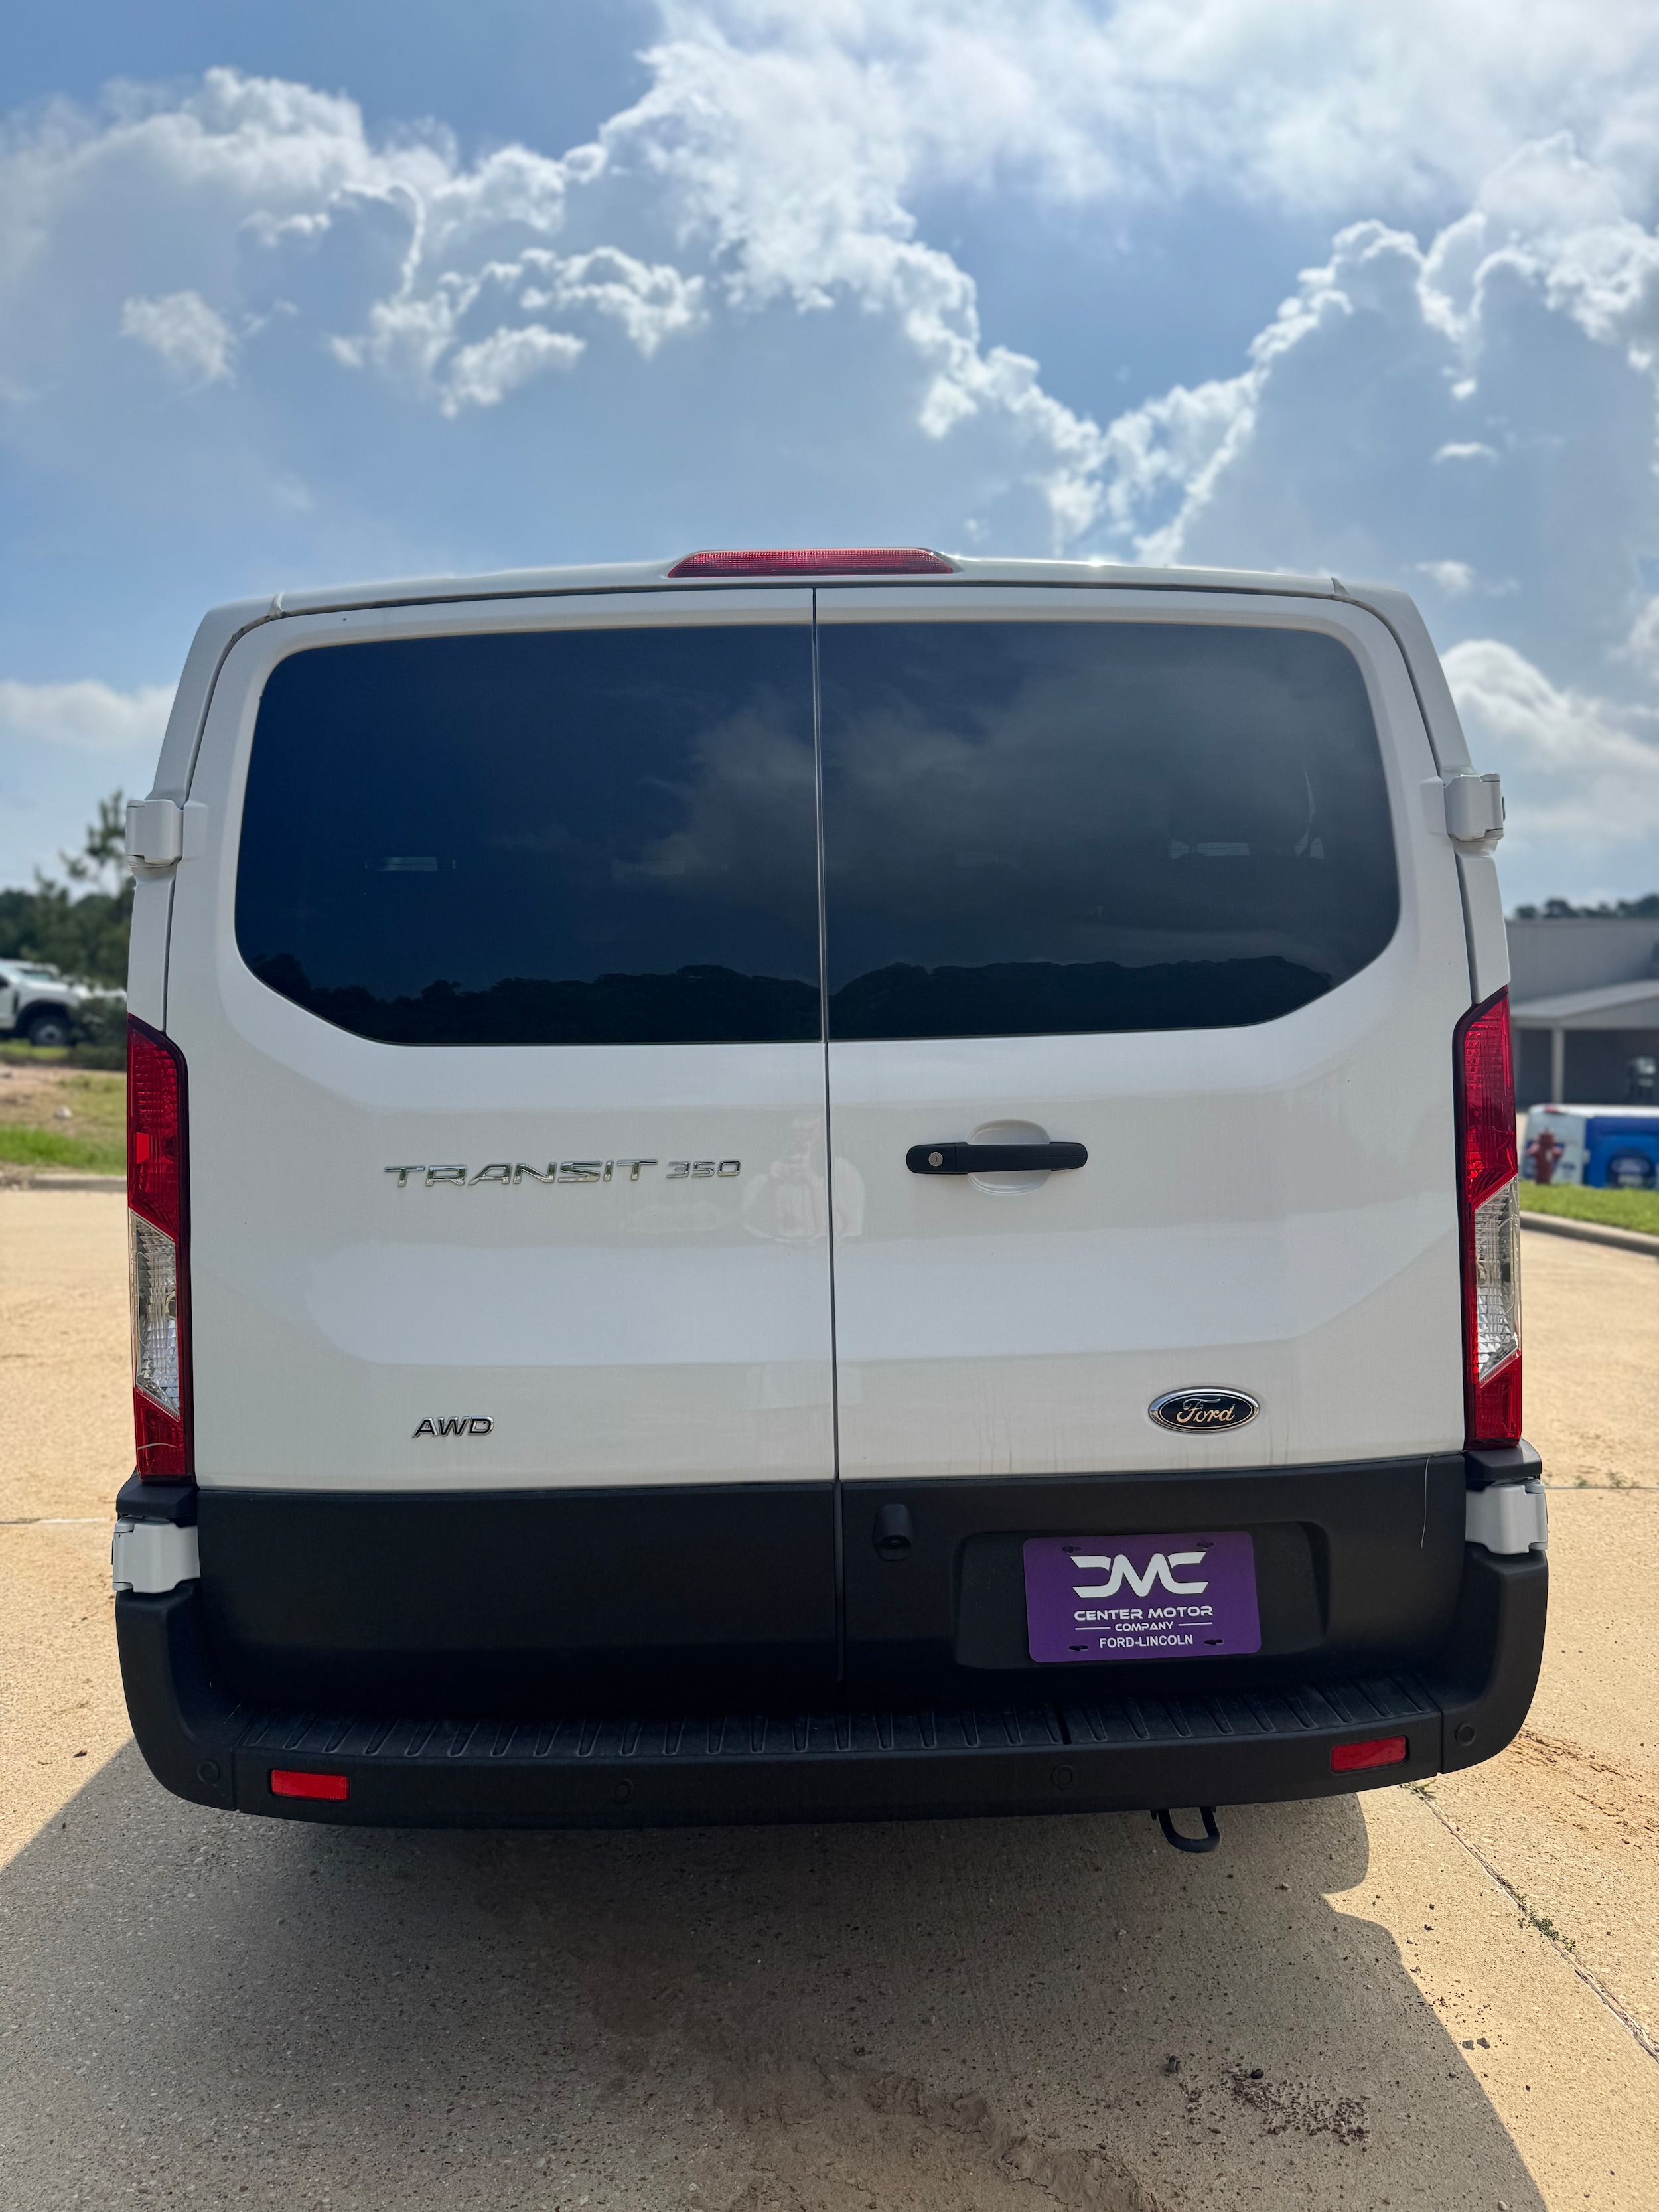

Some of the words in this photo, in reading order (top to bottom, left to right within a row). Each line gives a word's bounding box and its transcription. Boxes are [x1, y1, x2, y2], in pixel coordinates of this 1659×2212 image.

[384, 1159, 659, 1187] TRANSIT
[666, 1160, 742, 1179] 350
[1176, 1398, 1236, 1423] Ford
[412, 1416, 494, 1438] AWD
[1074, 1609, 1143, 1621] CENTER
[1147, 1605, 1214, 1619] MOTOR
[1114, 1621, 1174, 1632] COMPANY
[1099, 1634, 1194, 1649] FORD-LINCOLN
